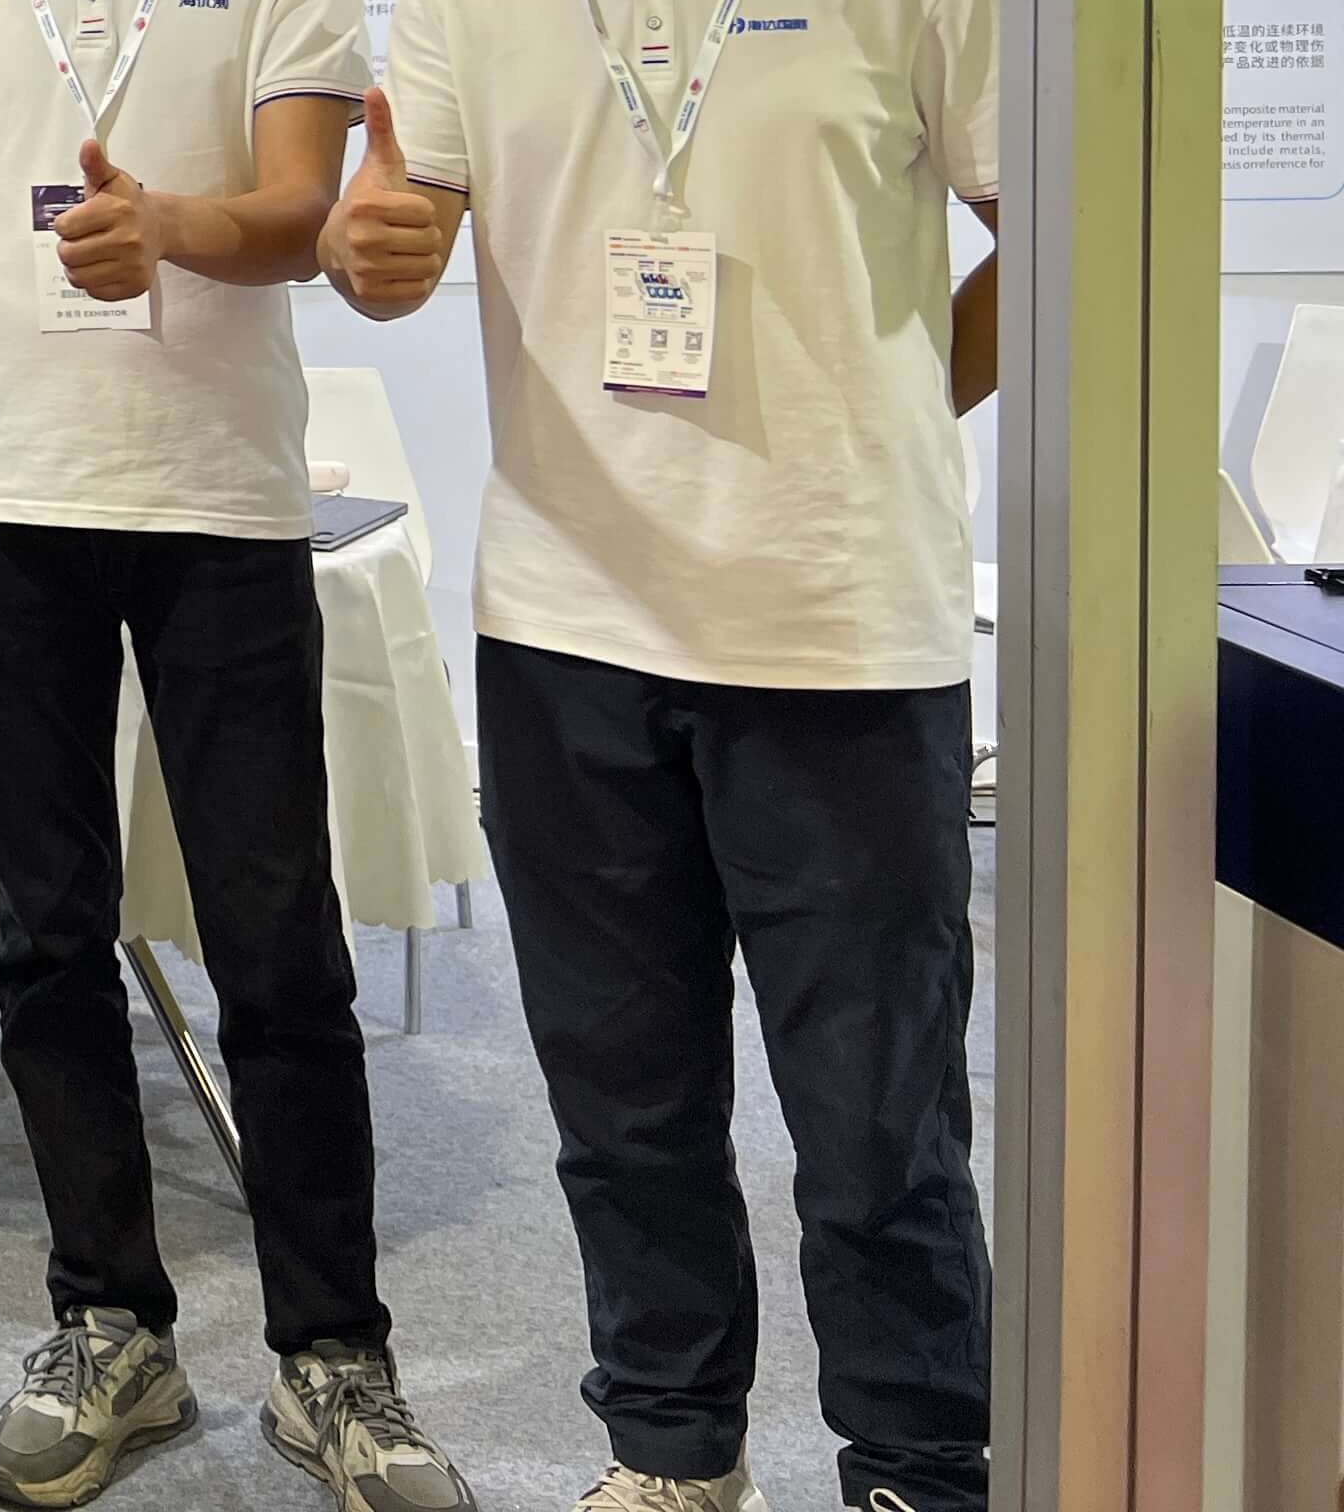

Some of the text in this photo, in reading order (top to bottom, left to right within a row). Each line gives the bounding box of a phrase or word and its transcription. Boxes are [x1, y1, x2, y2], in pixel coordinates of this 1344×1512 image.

[1278, 103, 1325, 114] material
[1296, 118, 1307, 128] in
[1310, 118, 1325, 128] an
[1243, 131, 1325, 144] by its thermal
[1228, 145, 1274, 156] include
[1309, 158, 1324, 169] for
